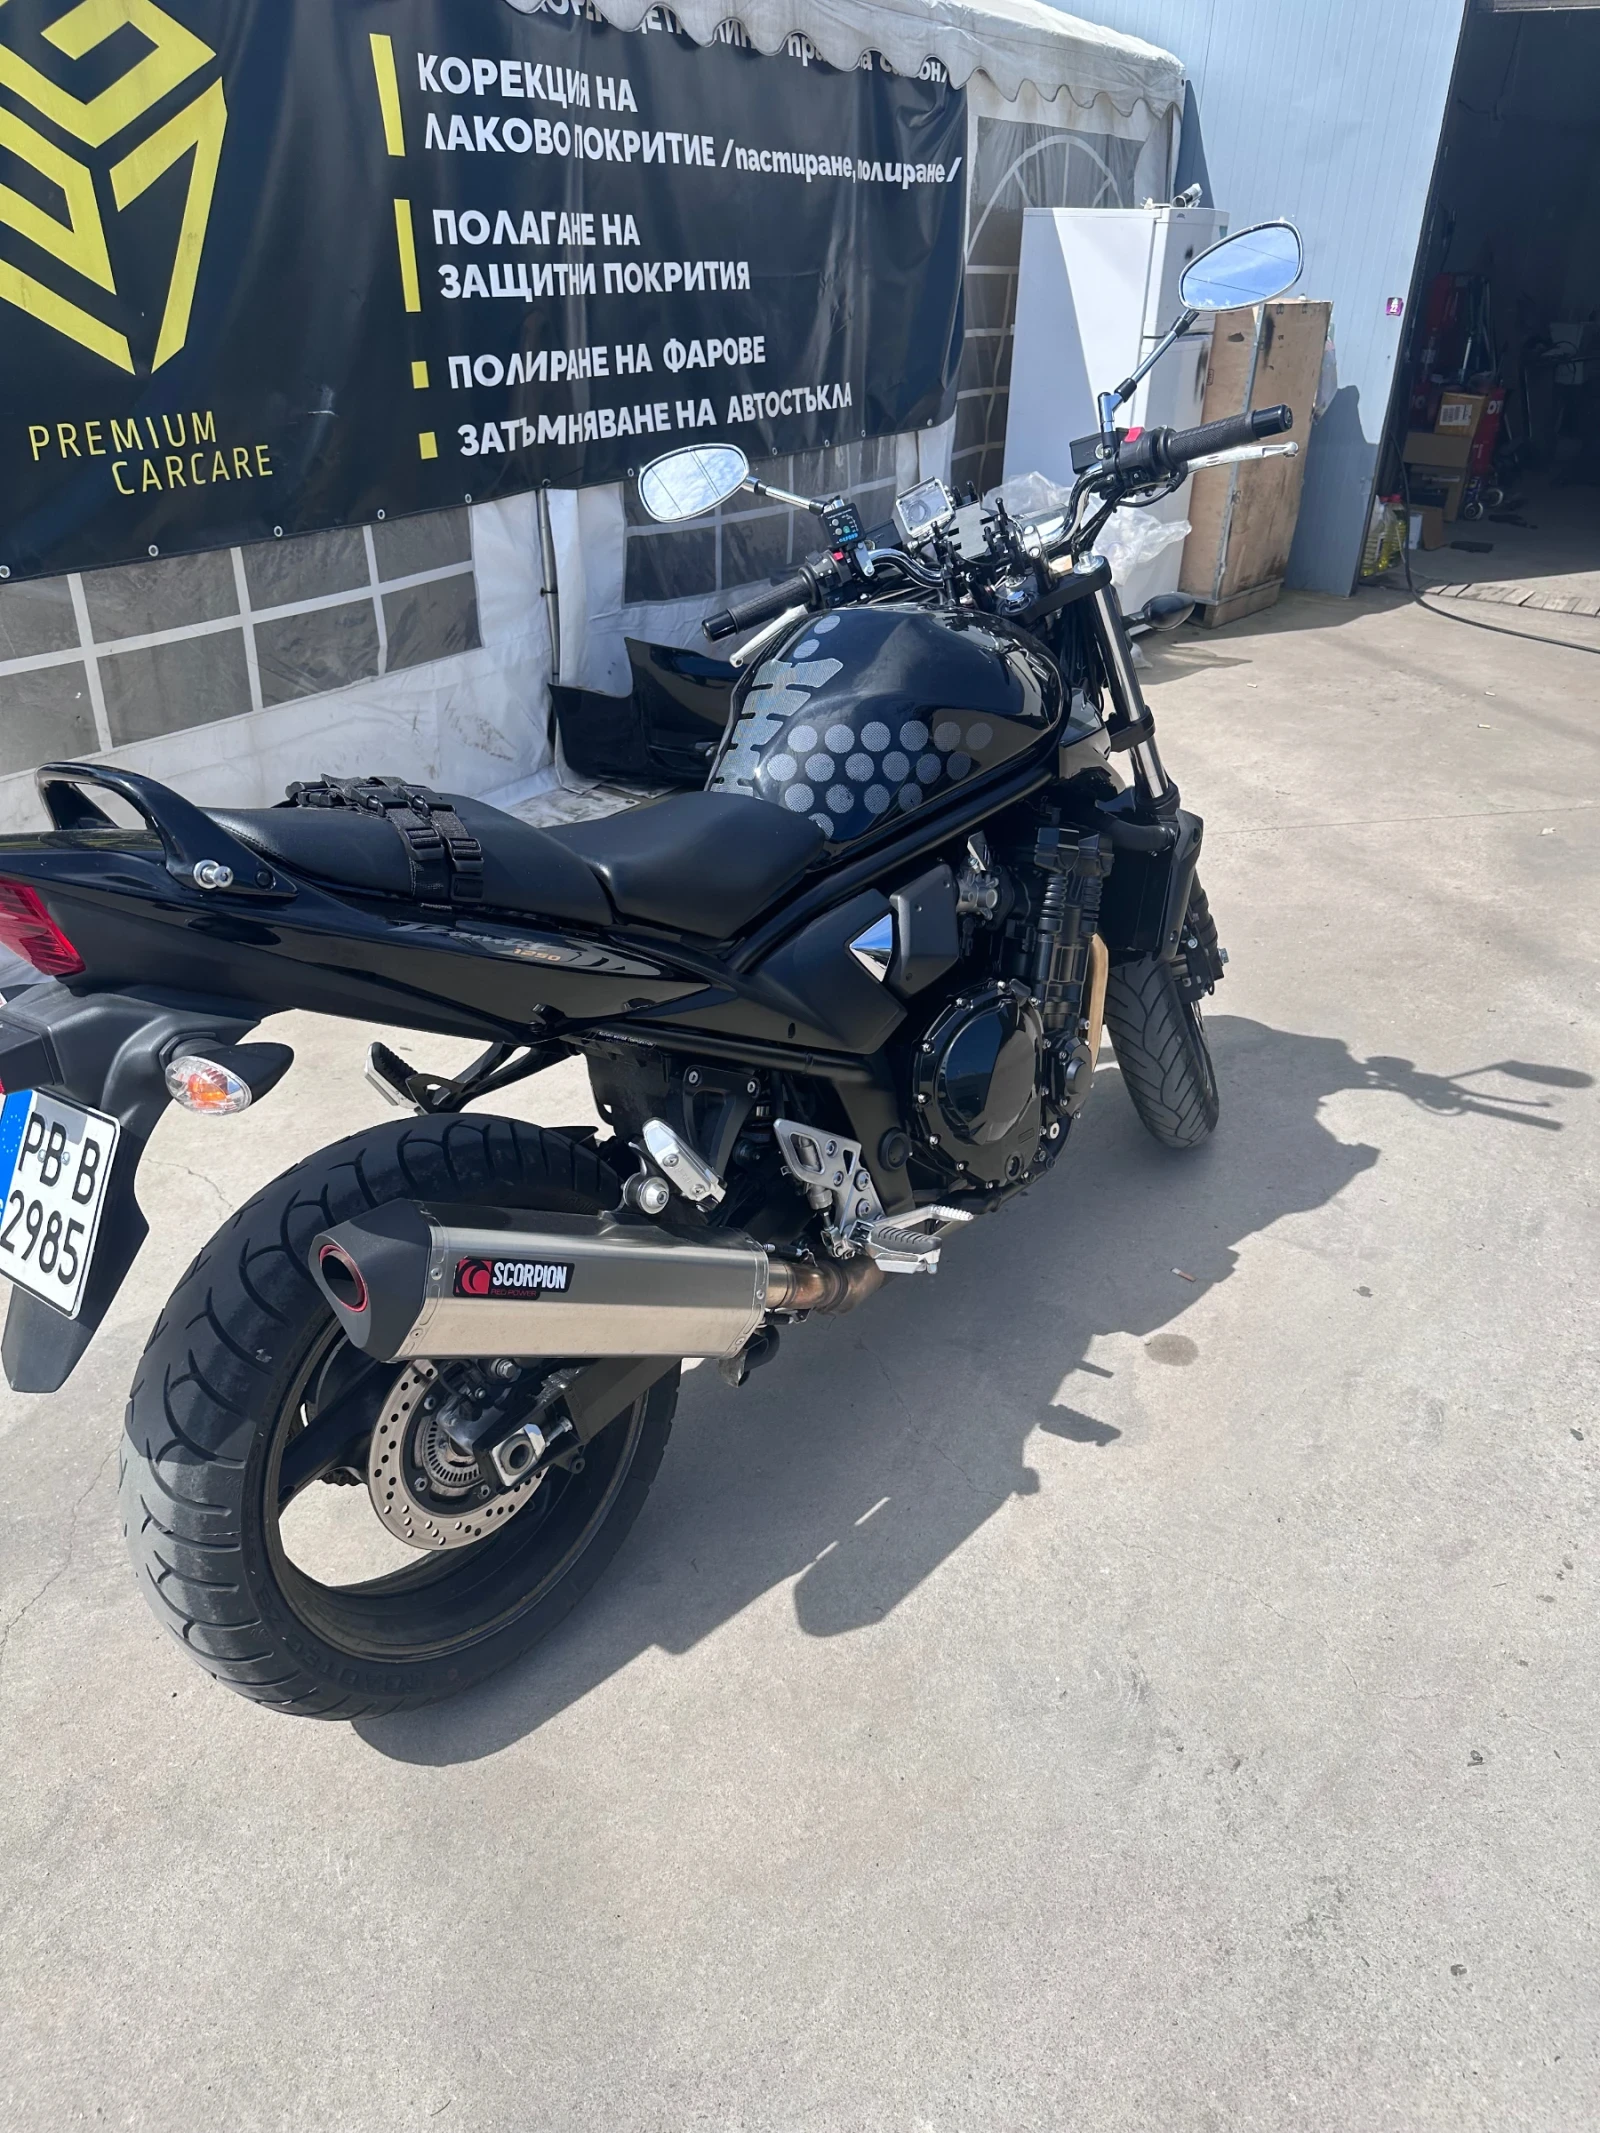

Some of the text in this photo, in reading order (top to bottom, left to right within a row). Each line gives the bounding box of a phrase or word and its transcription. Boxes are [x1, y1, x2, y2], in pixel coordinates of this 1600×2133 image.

[417, 52, 638, 112] КОРЕКЦИЯ НА
[425, 112, 571, 156] ЛАКОВО
[575, 123, 715, 167] ПОКРИТИЕ
[433, 209, 641, 245] ПОЛАГАНЕ НА
[438, 261, 751, 302] ЗАЩИТНИ ПОКРИТИЯ
[448, 335, 766, 388] ПОЛИРАНЕ НА ФАРОВЕ
[28, 411, 218, 460] PREMIUM
[458, 382, 853, 456] ЗАТЪМНЯВАНЕ НА АВТОСТЪКЛА
[111, 445, 274, 495] CARCARE
[512, 947, 562, 962] 1250
[18, 1111, 101, 1205] PB B
[0, 1189, 86, 1286] 2985
[491, 1288, 537, 1297] RED POWER
[492, 1261, 567, 1289] SCORPION
